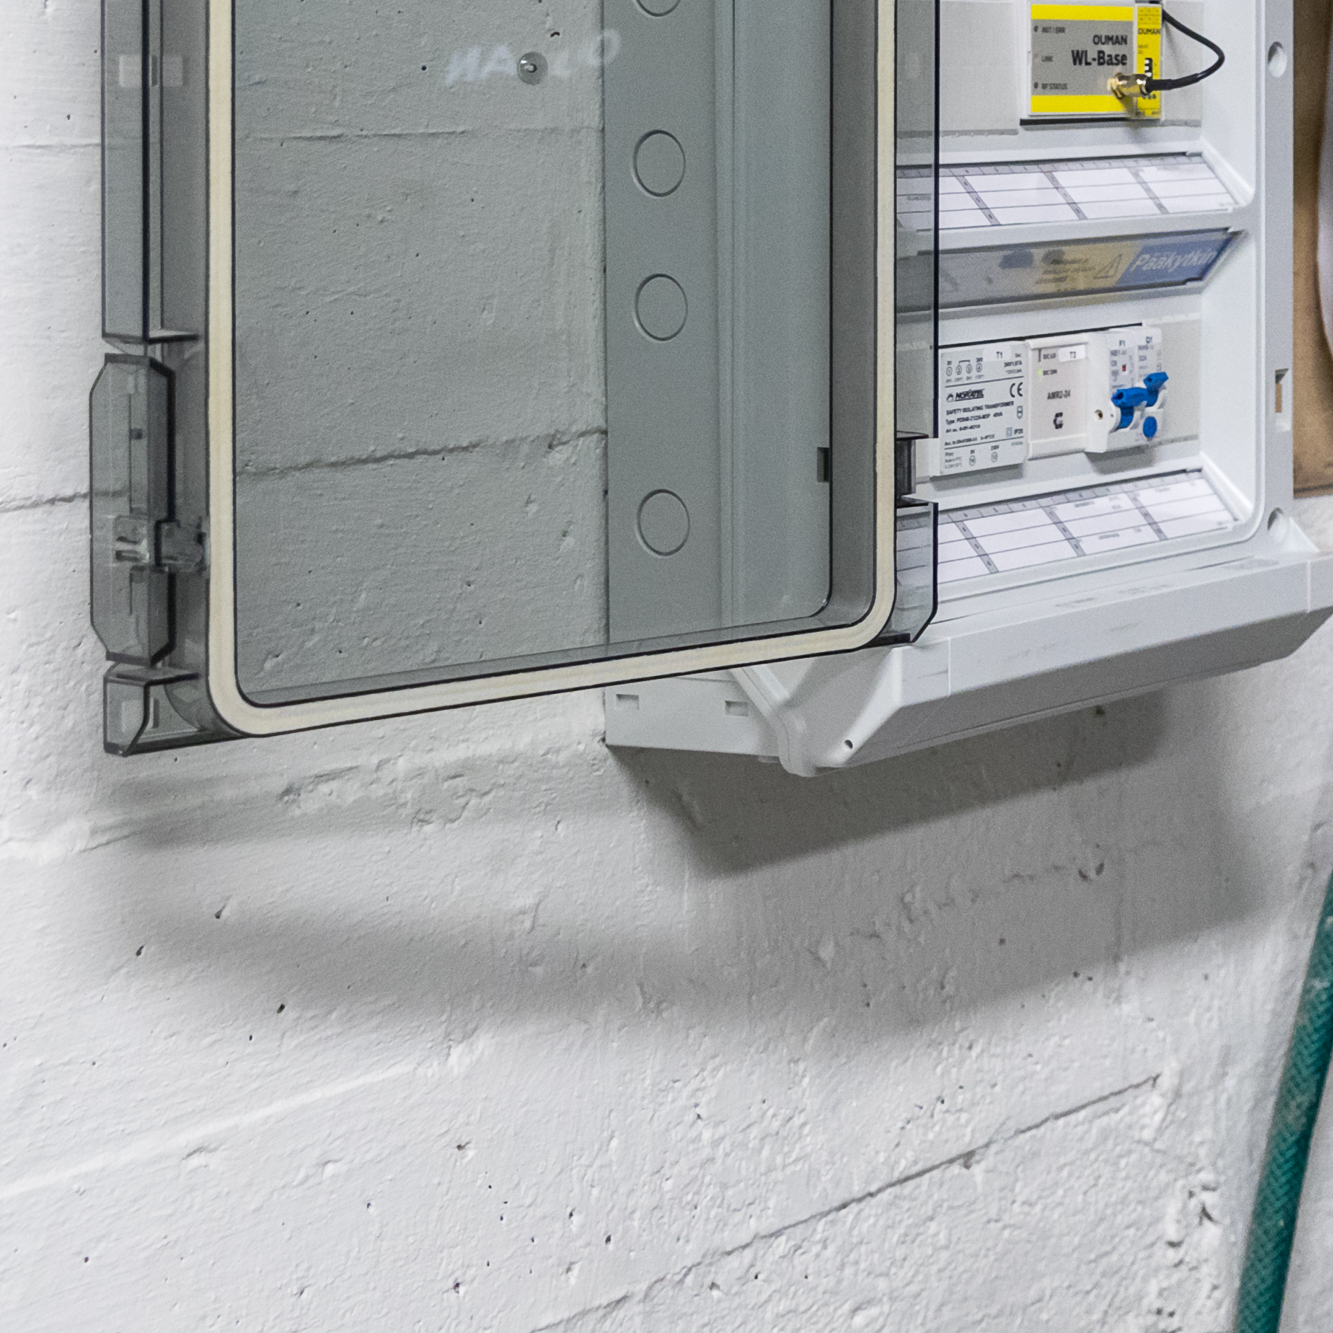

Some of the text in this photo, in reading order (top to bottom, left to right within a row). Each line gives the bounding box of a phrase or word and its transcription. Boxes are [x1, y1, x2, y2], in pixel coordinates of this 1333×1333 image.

[1092, 34, 1128, 46] OUMAN
[1071, 49, 1128, 67] WL-Base
[996, 351, 1003, 359] T1
